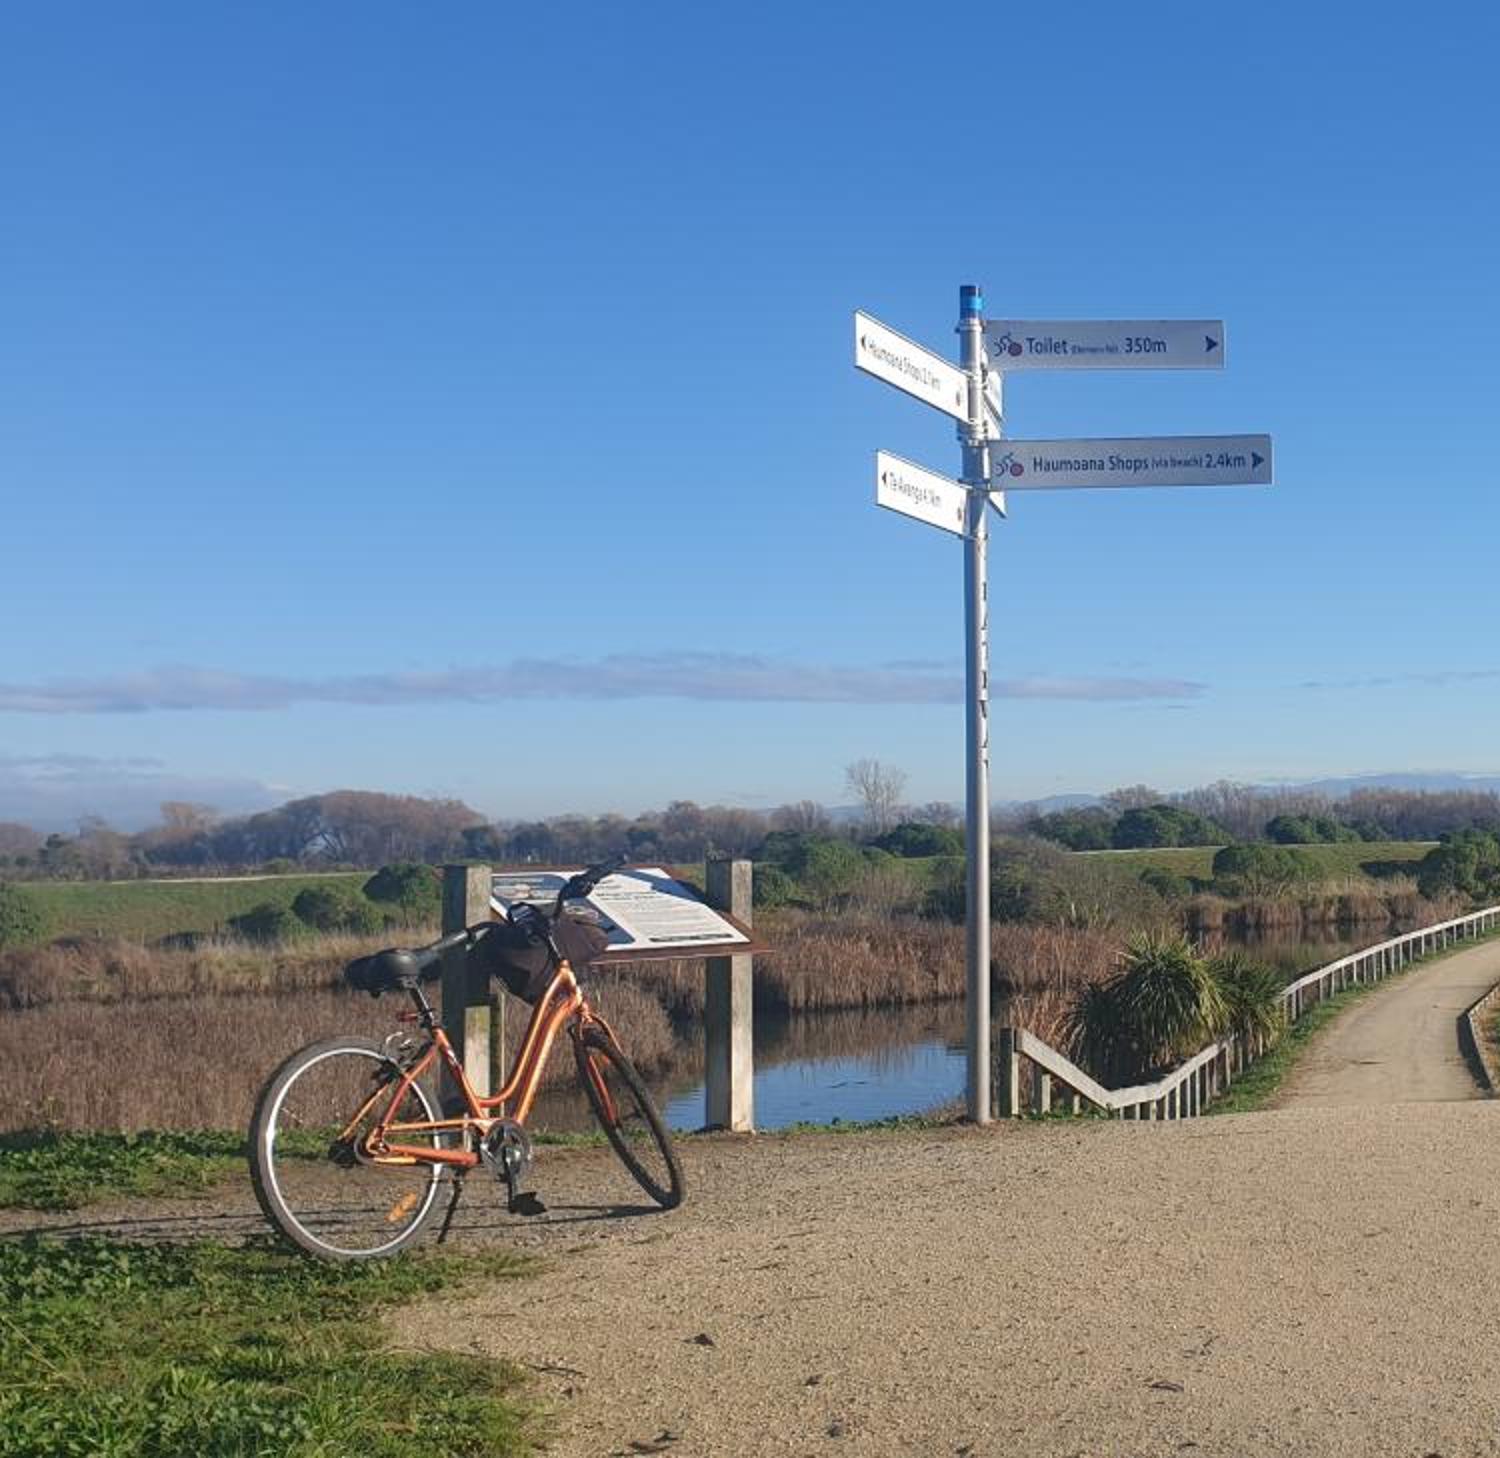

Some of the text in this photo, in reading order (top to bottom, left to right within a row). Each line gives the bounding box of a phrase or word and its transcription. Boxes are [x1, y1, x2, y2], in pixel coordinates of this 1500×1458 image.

[1026, 337, 1068, 355] Toilet
[1125, 337, 1167, 354] 350m
[1033, 455, 1105, 473] Haumoana
[1109, 454, 1149, 474] Shops
[1205, 452, 1246, 469] 2.4km
